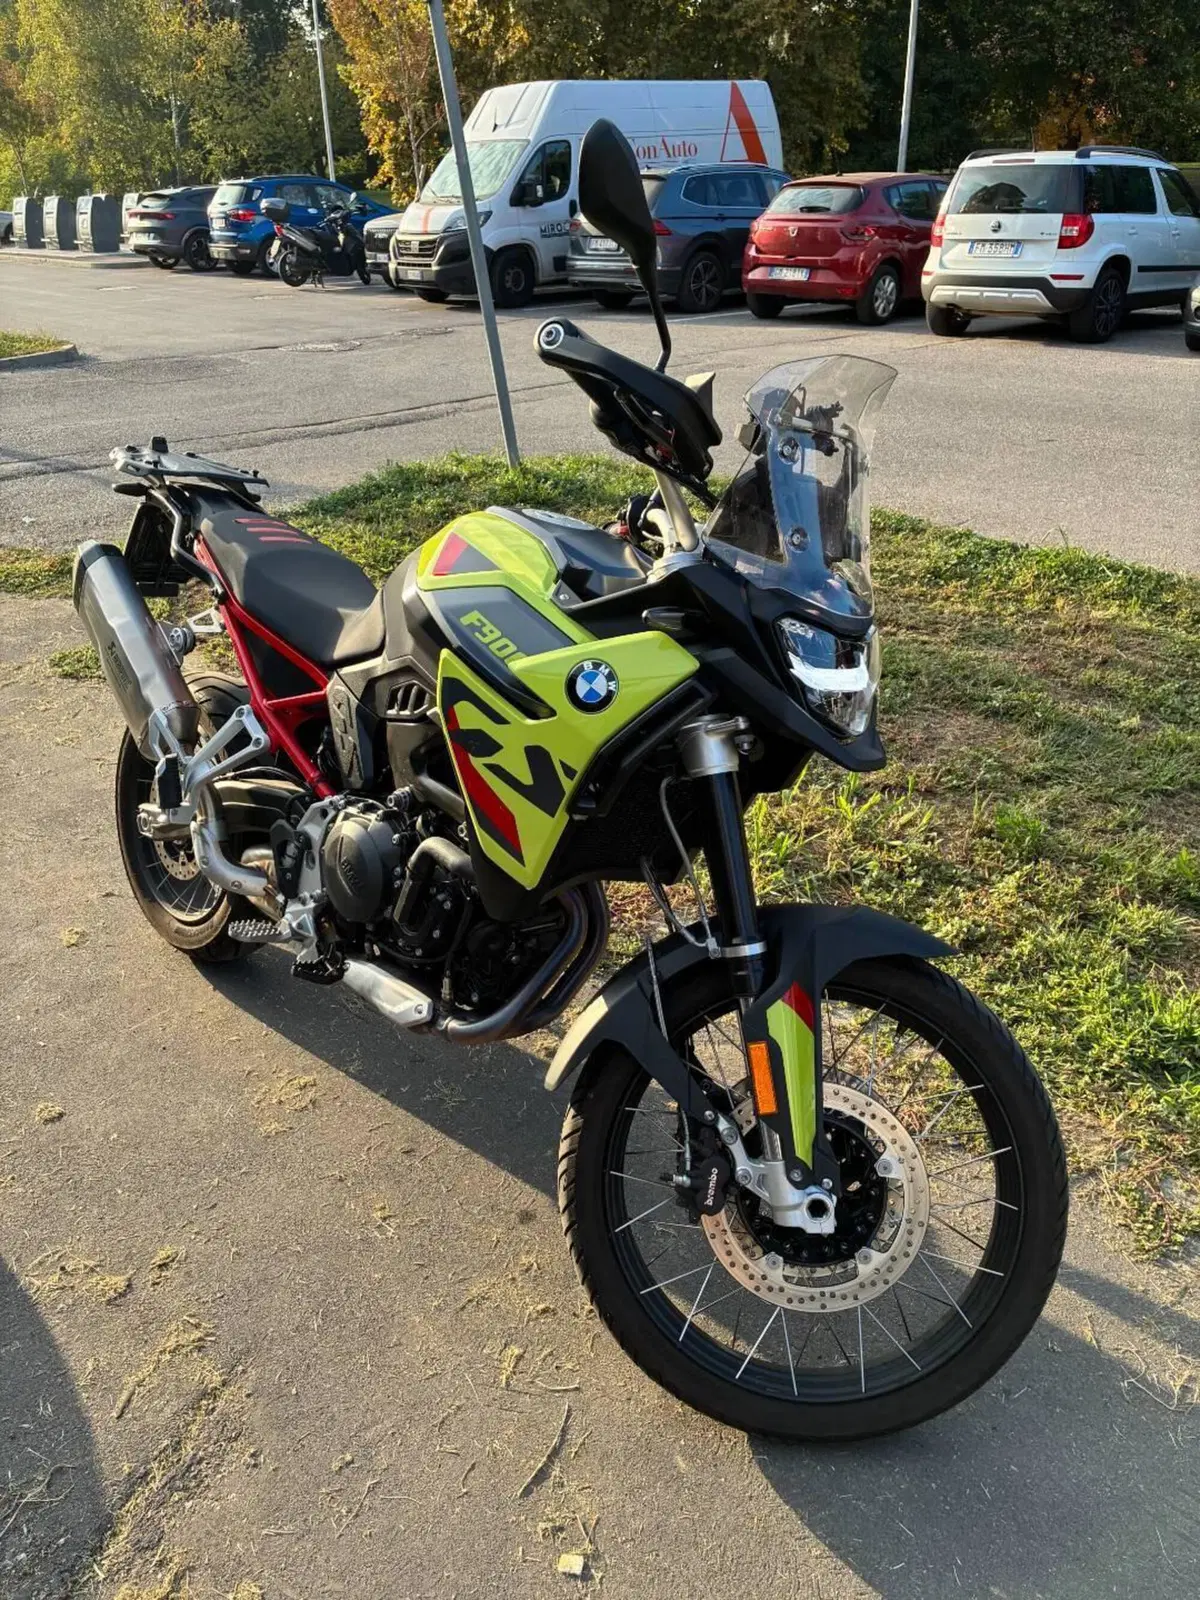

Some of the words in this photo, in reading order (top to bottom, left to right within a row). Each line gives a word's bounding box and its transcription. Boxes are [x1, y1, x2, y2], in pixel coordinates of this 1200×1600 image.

[633, 135, 698, 159] onAuto
[583, 660, 617, 692] BMW
[704, 1167, 718, 1206] brembo
